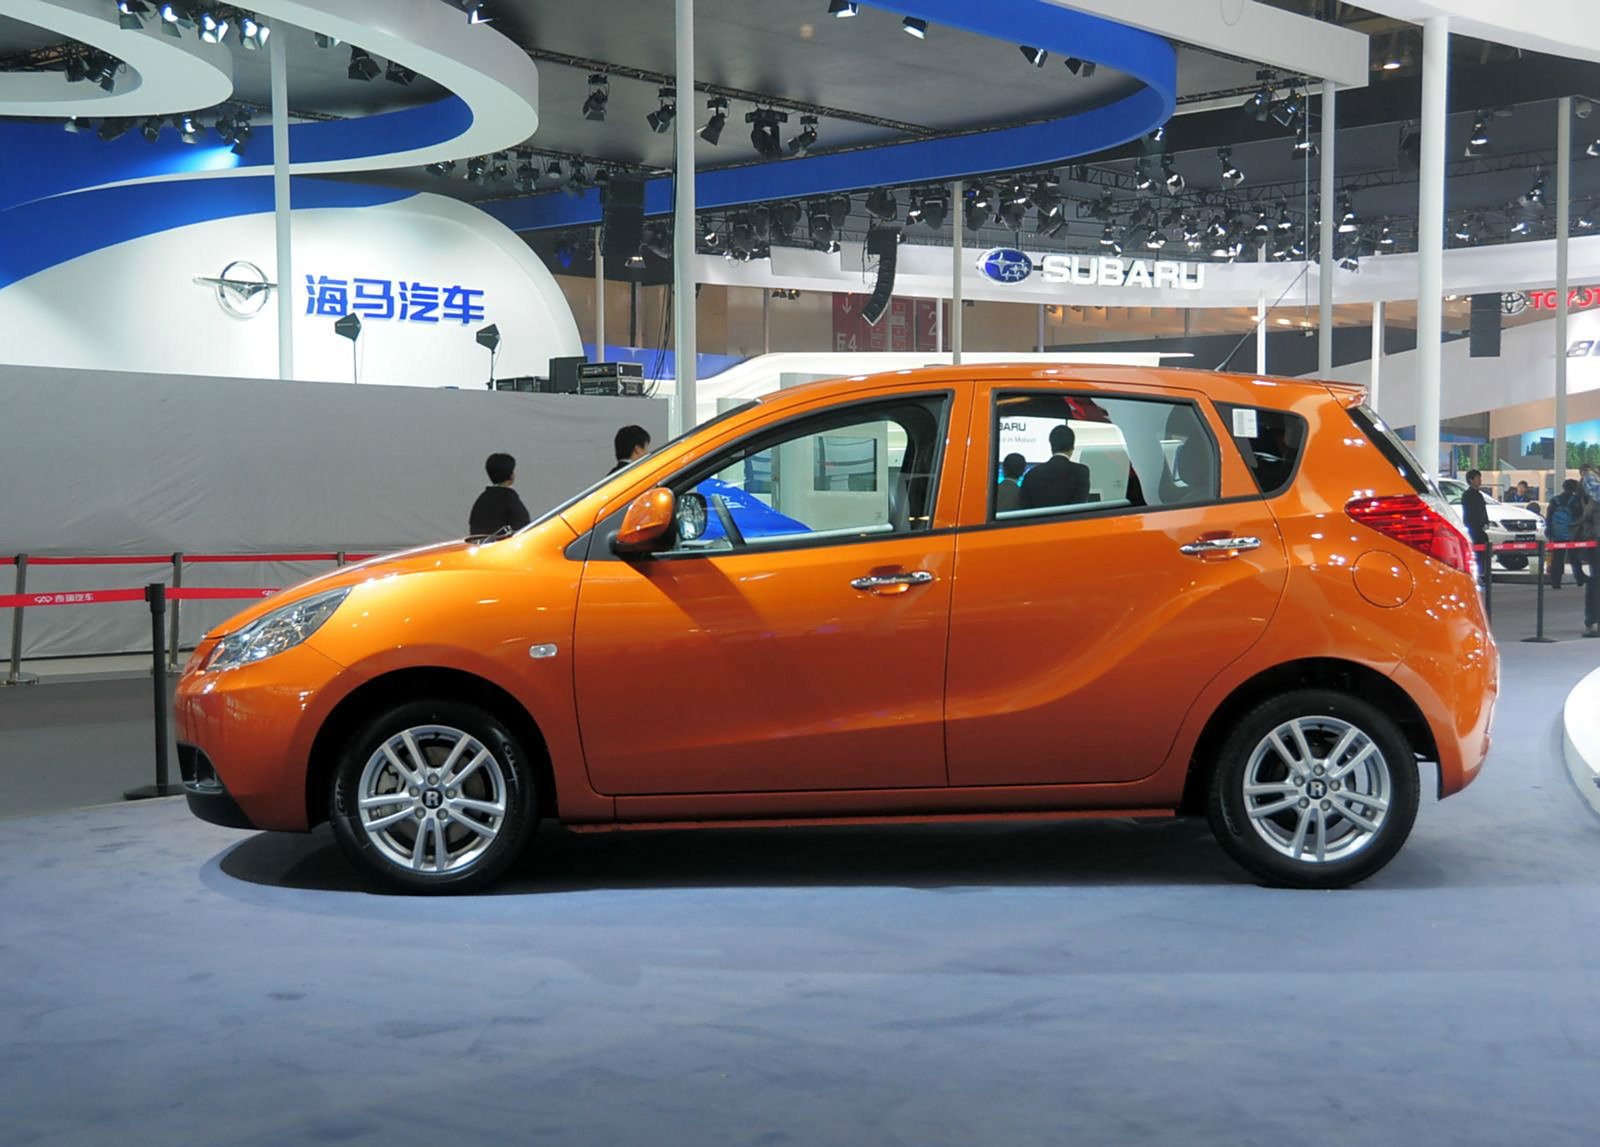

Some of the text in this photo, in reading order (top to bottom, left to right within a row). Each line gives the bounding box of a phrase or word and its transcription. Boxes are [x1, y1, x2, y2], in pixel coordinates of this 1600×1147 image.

[1042, 255, 1205, 290] SUBARU
[305, 274, 485, 325] 海马汽车
